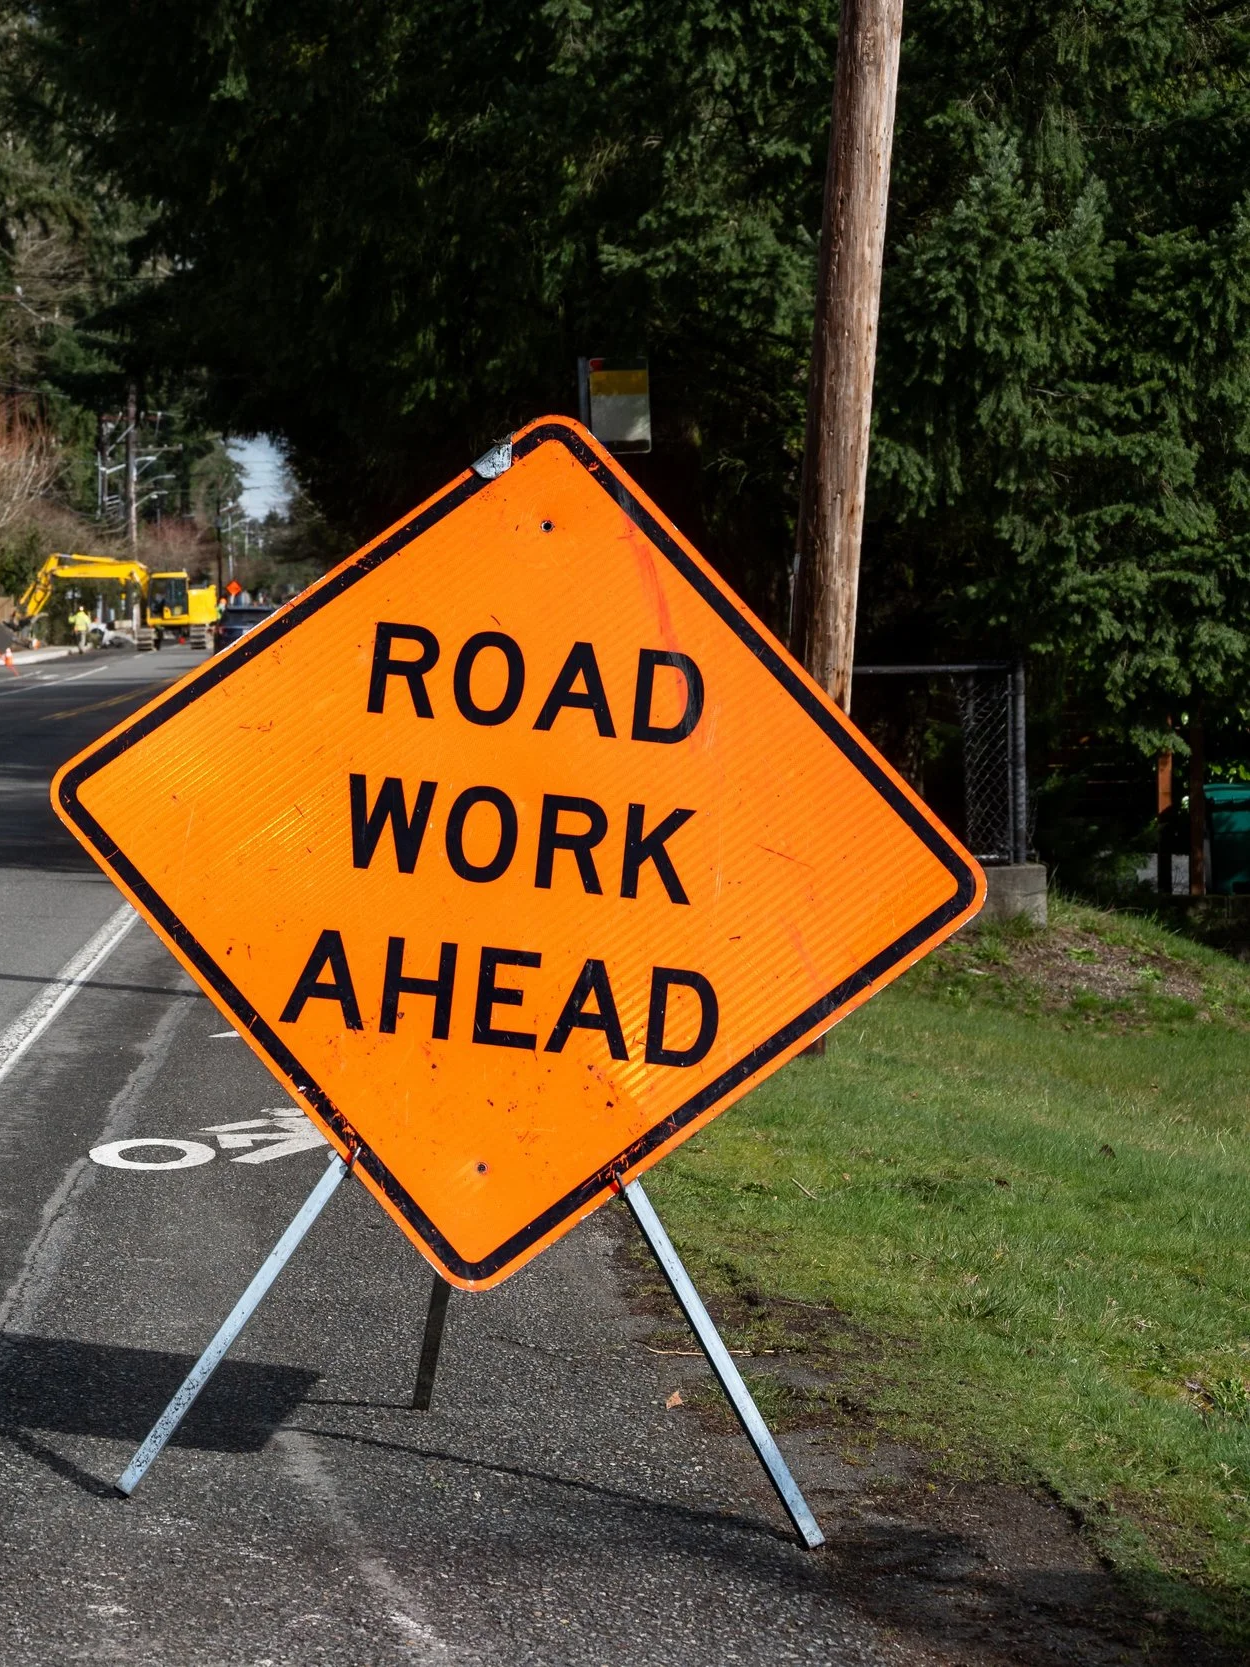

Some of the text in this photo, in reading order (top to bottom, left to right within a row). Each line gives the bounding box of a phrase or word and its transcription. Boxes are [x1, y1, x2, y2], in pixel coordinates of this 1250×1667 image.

[367, 621, 705, 745] ROAD
[349, 773, 696, 905] WORK
[278, 929, 719, 1068] AHEAD
